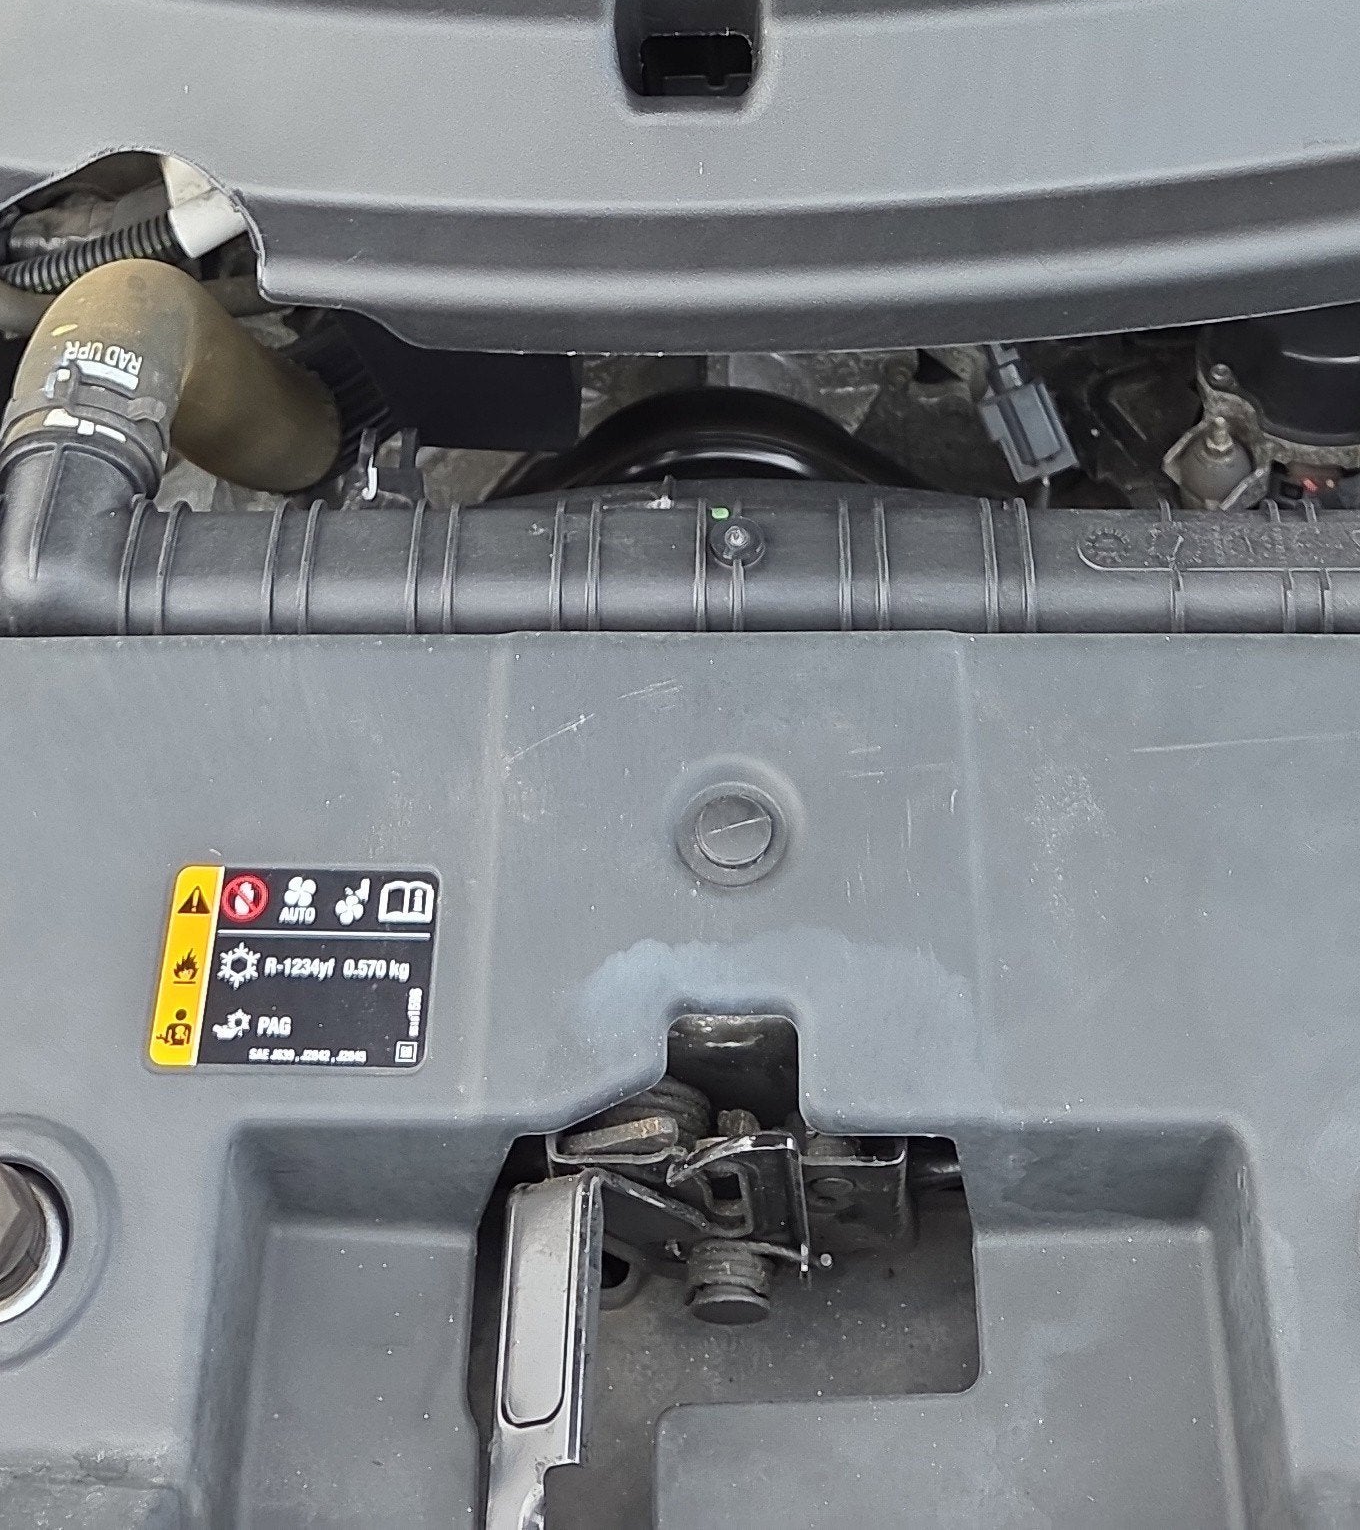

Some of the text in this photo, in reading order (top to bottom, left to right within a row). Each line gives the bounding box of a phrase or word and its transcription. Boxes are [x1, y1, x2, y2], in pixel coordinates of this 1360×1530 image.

[62, 340, 143, 376] RAD UPR
[278, 906, 316, 925] AUTO
[263, 956, 411, 983] R-1234yf 0.570 kg
[256, 1016, 292, 1038] PAG
[248, 1047, 270, 1062] SAE
